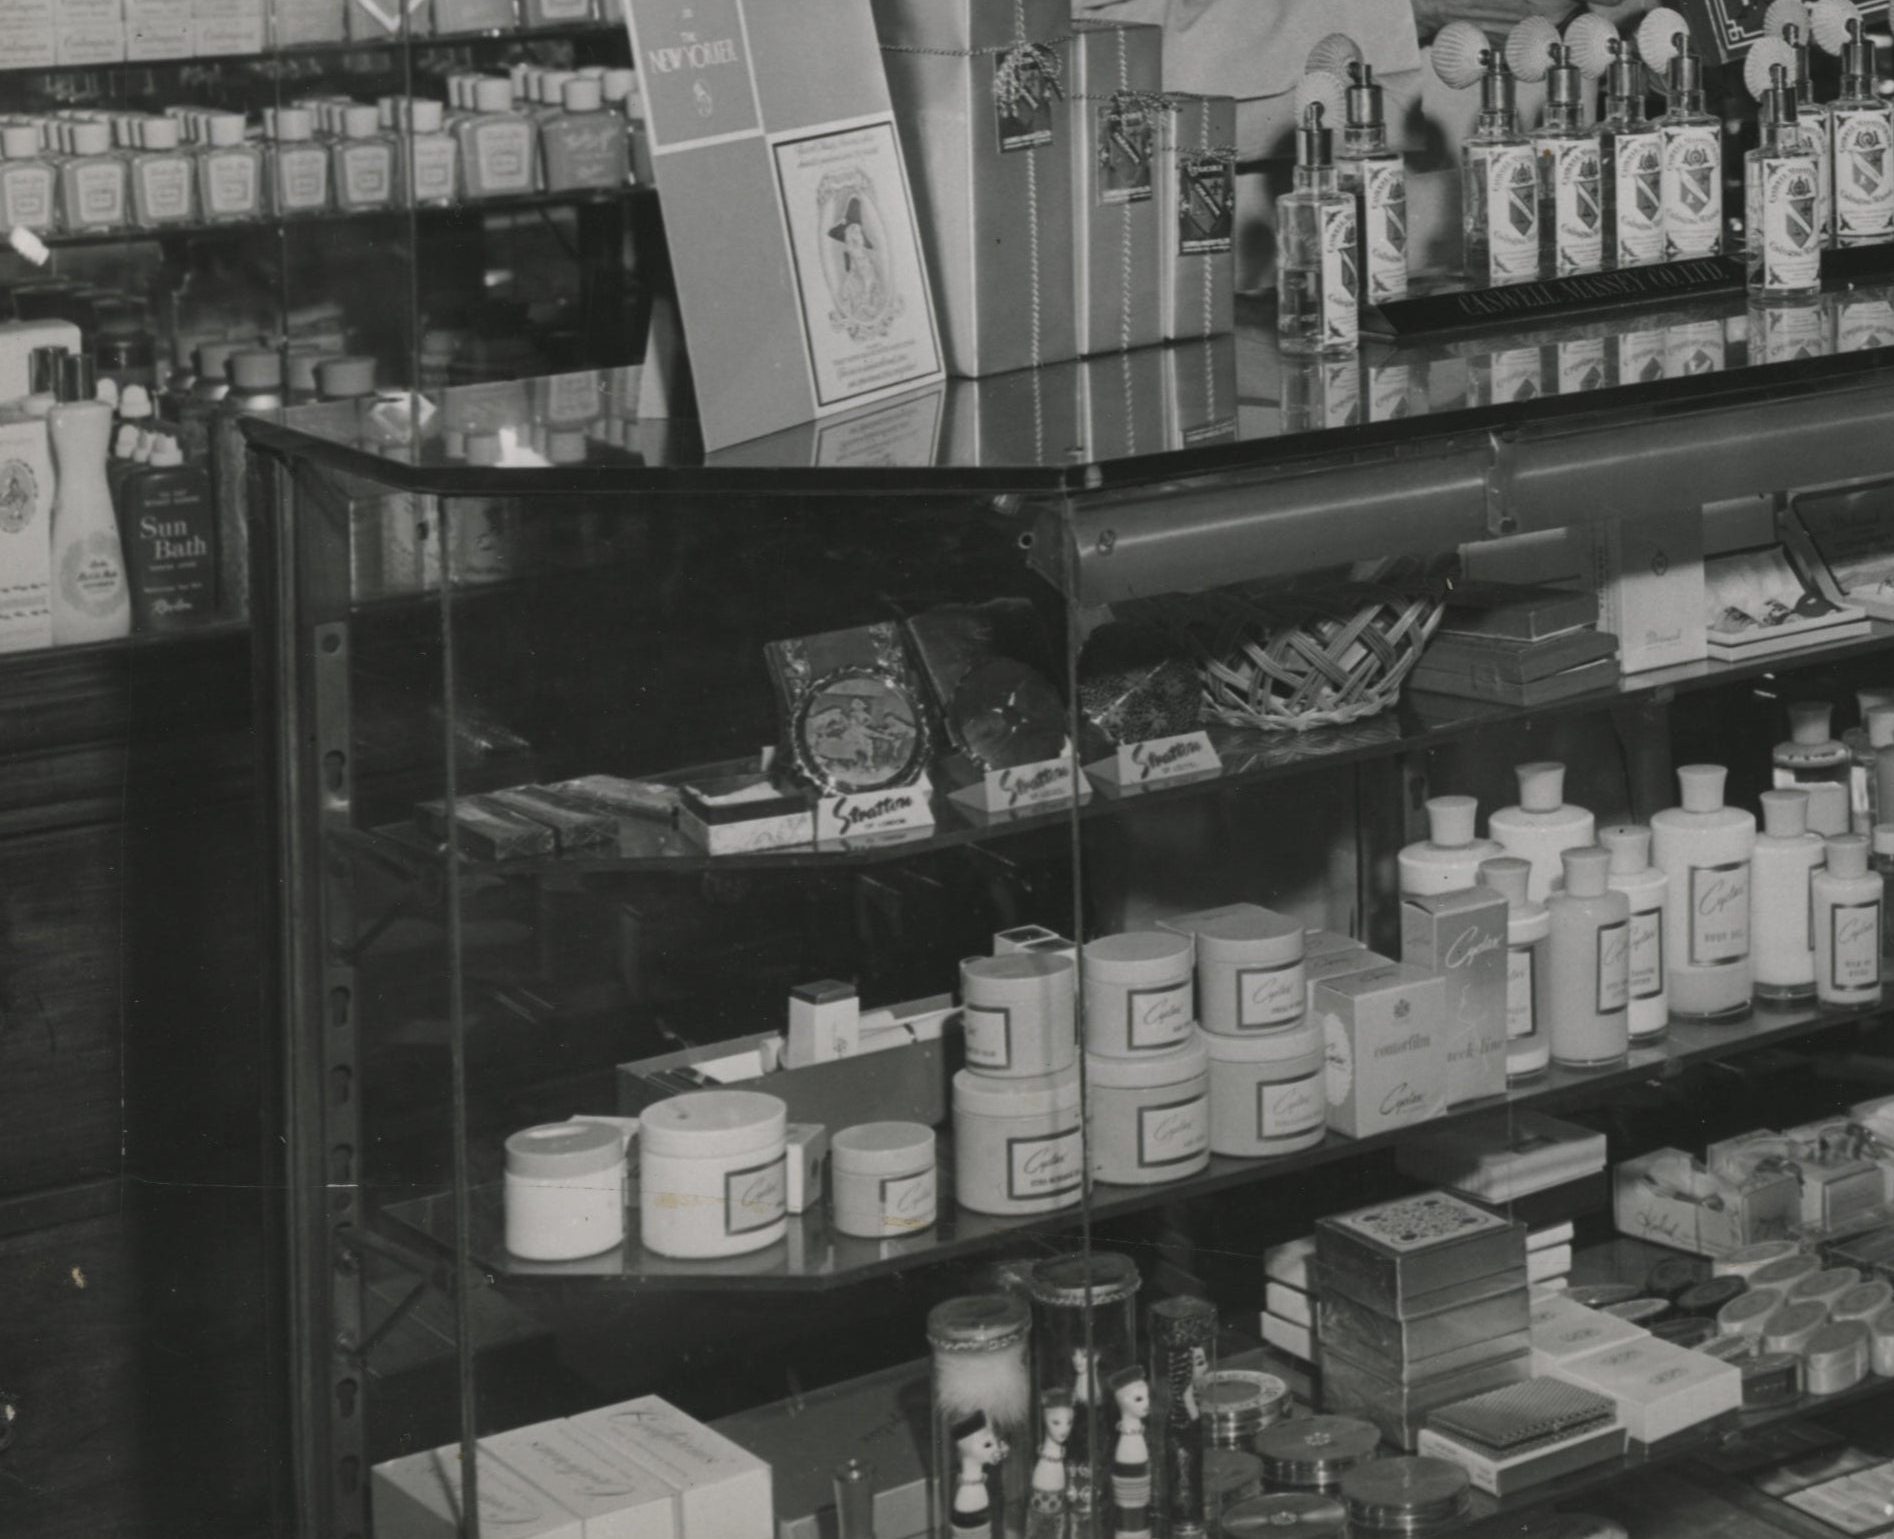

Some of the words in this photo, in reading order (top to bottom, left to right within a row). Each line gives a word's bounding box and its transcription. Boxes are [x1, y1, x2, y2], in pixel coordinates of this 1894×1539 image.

[647, 48, 682, 74] NEW
[1457, 283, 1561, 317] CASWELL
[1559, 270, 1647, 300] MASSEY
[140, 515, 188, 539] Sun
[153, 535, 207, 561] Bath
[1131, 740, 1203, 779] Stratton
[1000, 769, 1069, 806] Stratton
[833, 796, 914, 836] Stratton
[1446, 926, 1502, 968] Cyclax
[1379, 1081, 1424, 1116] Cyclax
